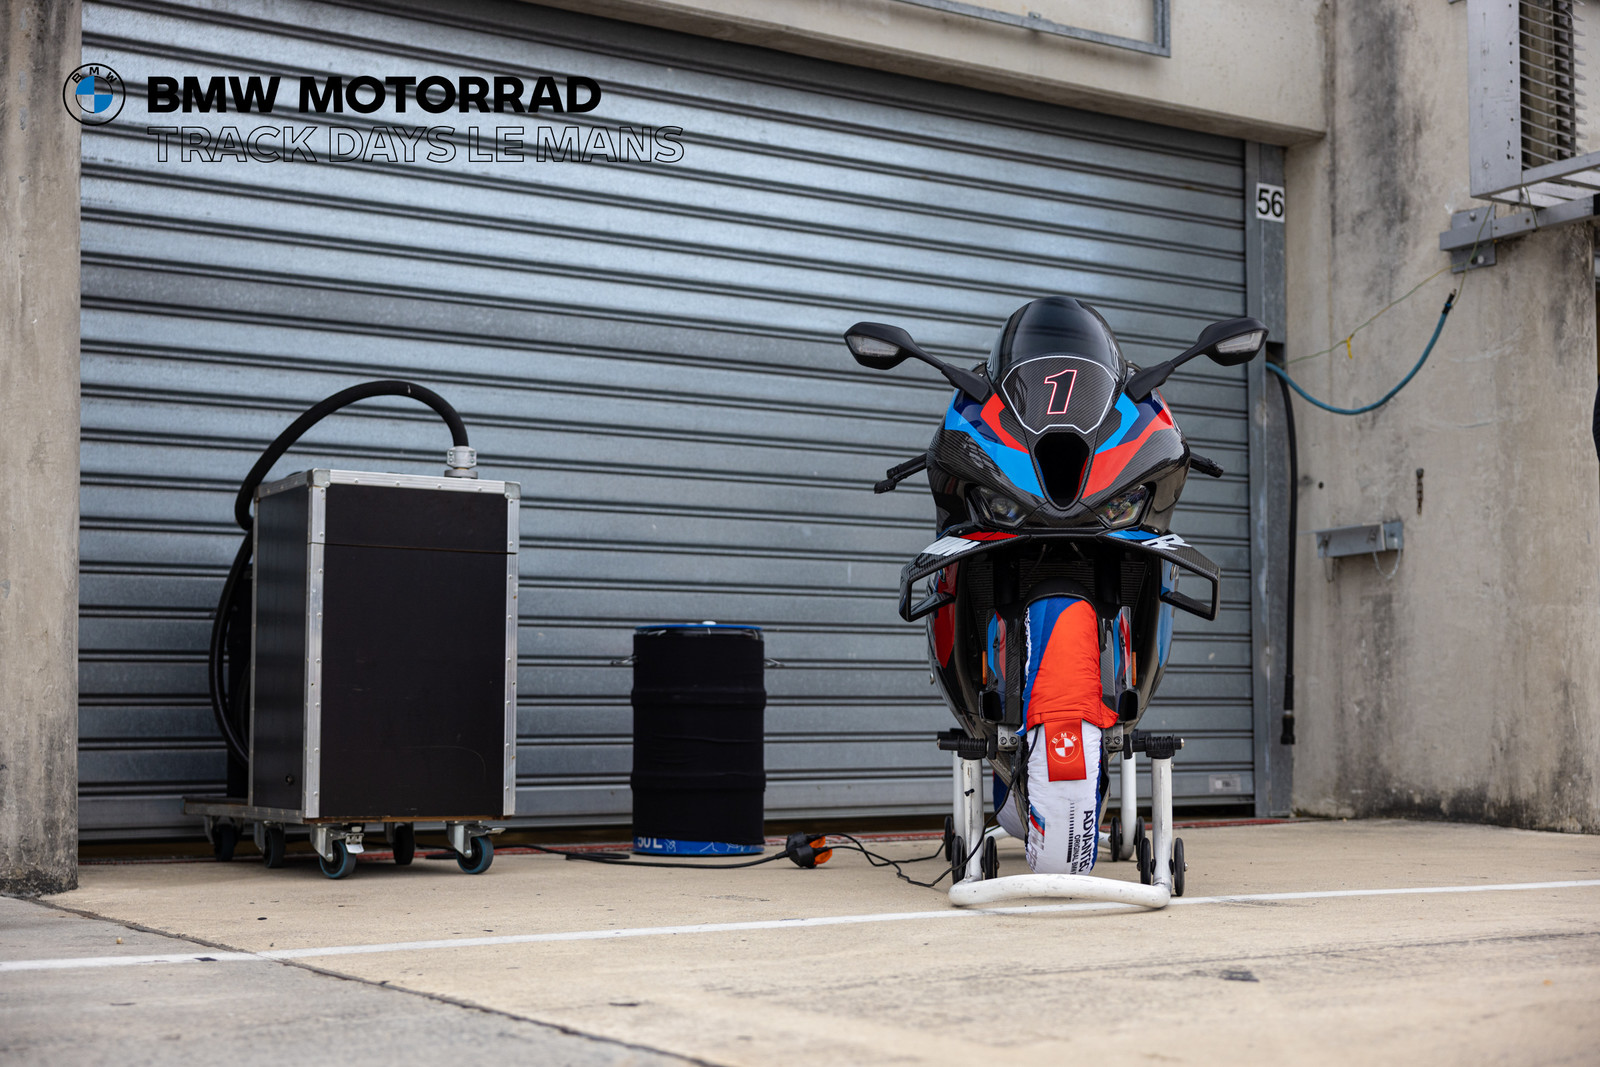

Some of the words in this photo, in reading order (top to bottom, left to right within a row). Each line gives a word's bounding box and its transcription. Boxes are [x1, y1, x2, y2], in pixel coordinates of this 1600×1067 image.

[1258, 189, 1283, 217] 56
[1043, 369, 1078, 415] 1
[1051, 732, 1078, 744] BMW
[1071, 834, 1081, 862] ORIGINAL
[1078, 810, 1094, 872] ADVANTEC
